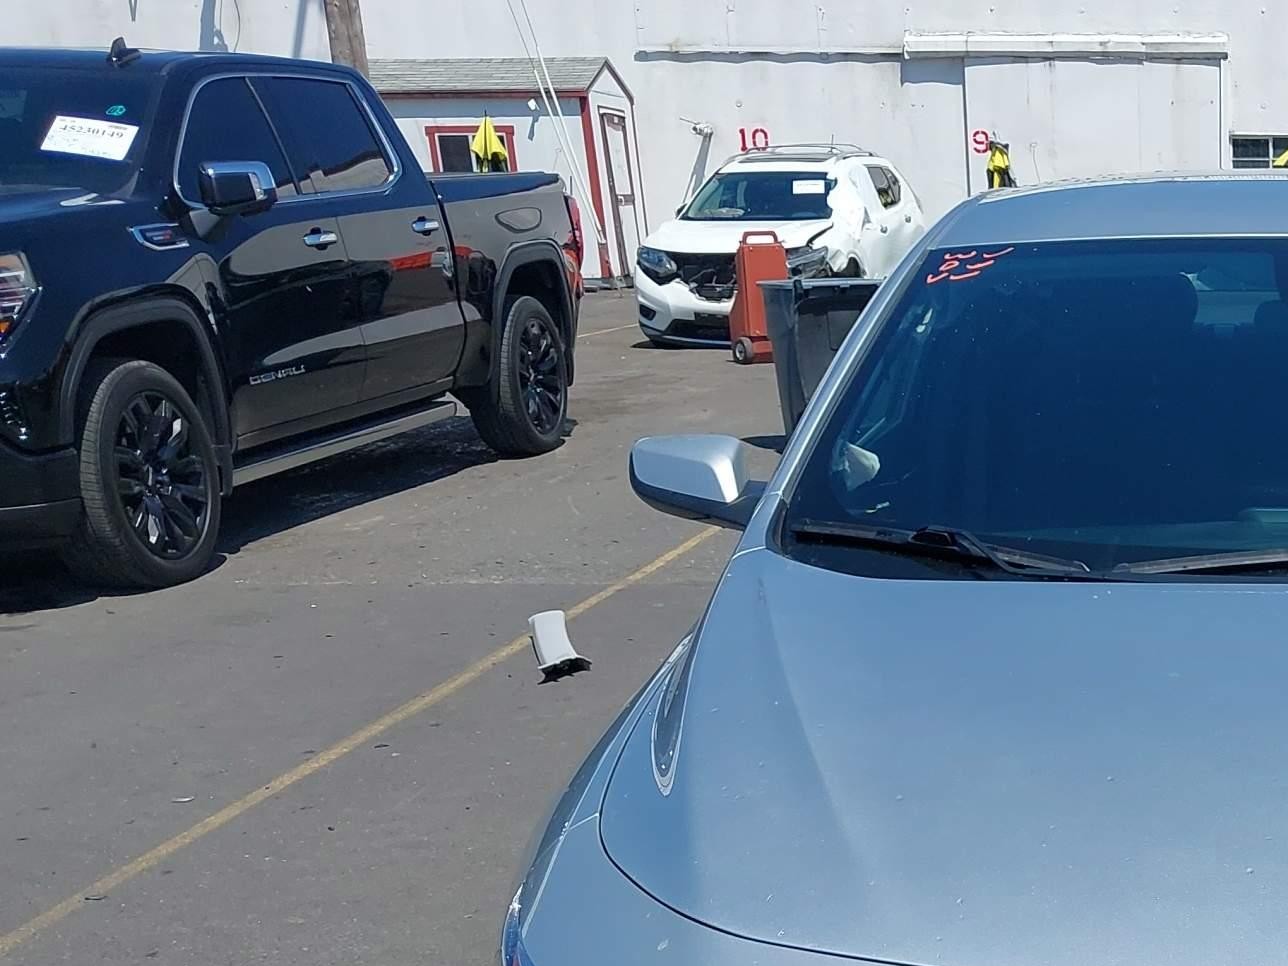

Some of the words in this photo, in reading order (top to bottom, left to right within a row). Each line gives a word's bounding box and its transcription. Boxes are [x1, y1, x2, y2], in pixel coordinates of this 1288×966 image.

[738, 127, 769, 152] 10
[973, 130, 990, 154] 9
[249, 364, 306, 385] DENALI
